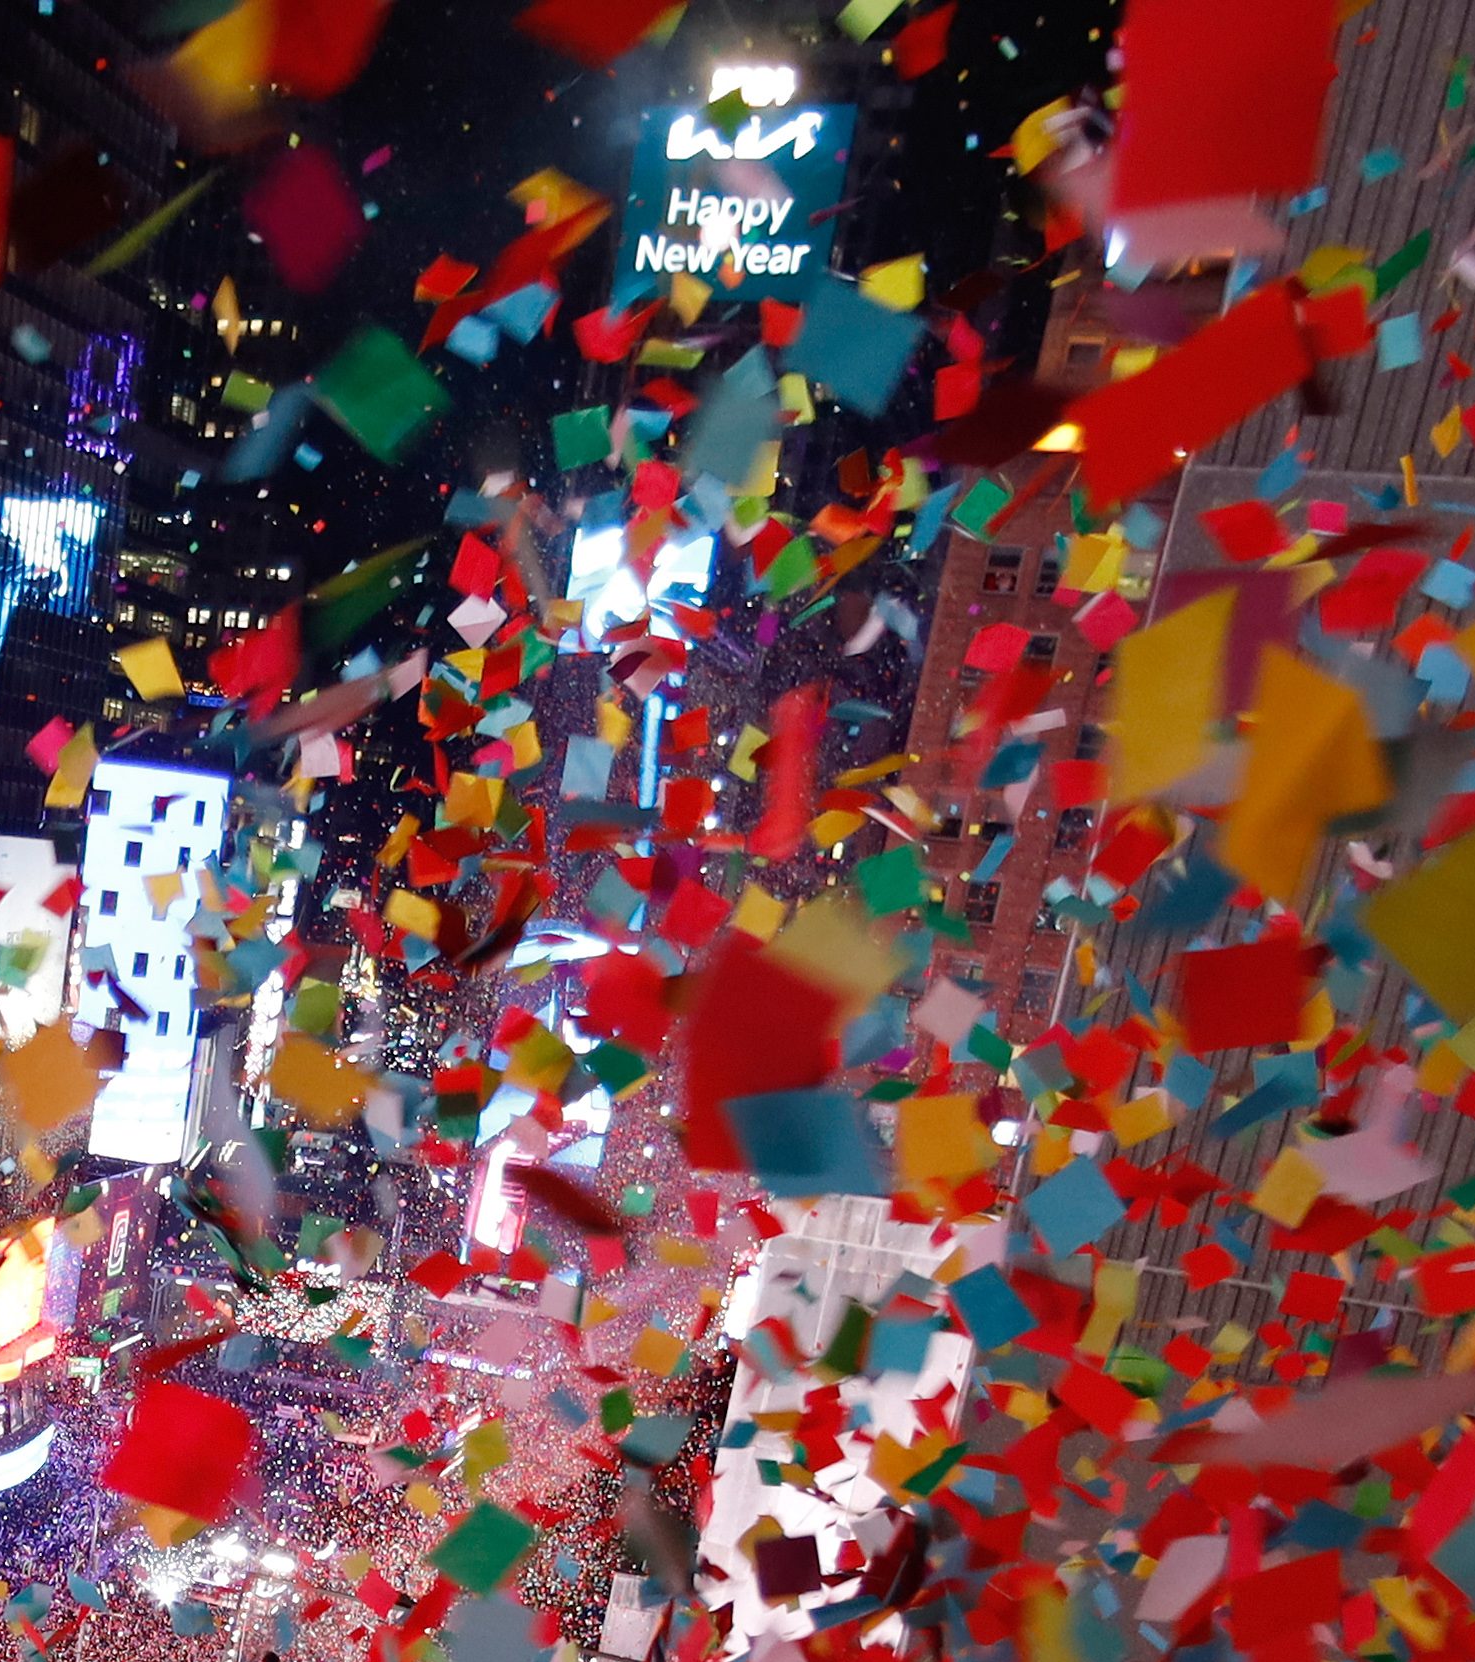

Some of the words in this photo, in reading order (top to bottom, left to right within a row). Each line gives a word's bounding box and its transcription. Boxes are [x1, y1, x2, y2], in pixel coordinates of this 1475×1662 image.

[667, 188, 794, 235] Happy
[635, 234, 719, 273] New
[730, 236, 811, 275] Year
